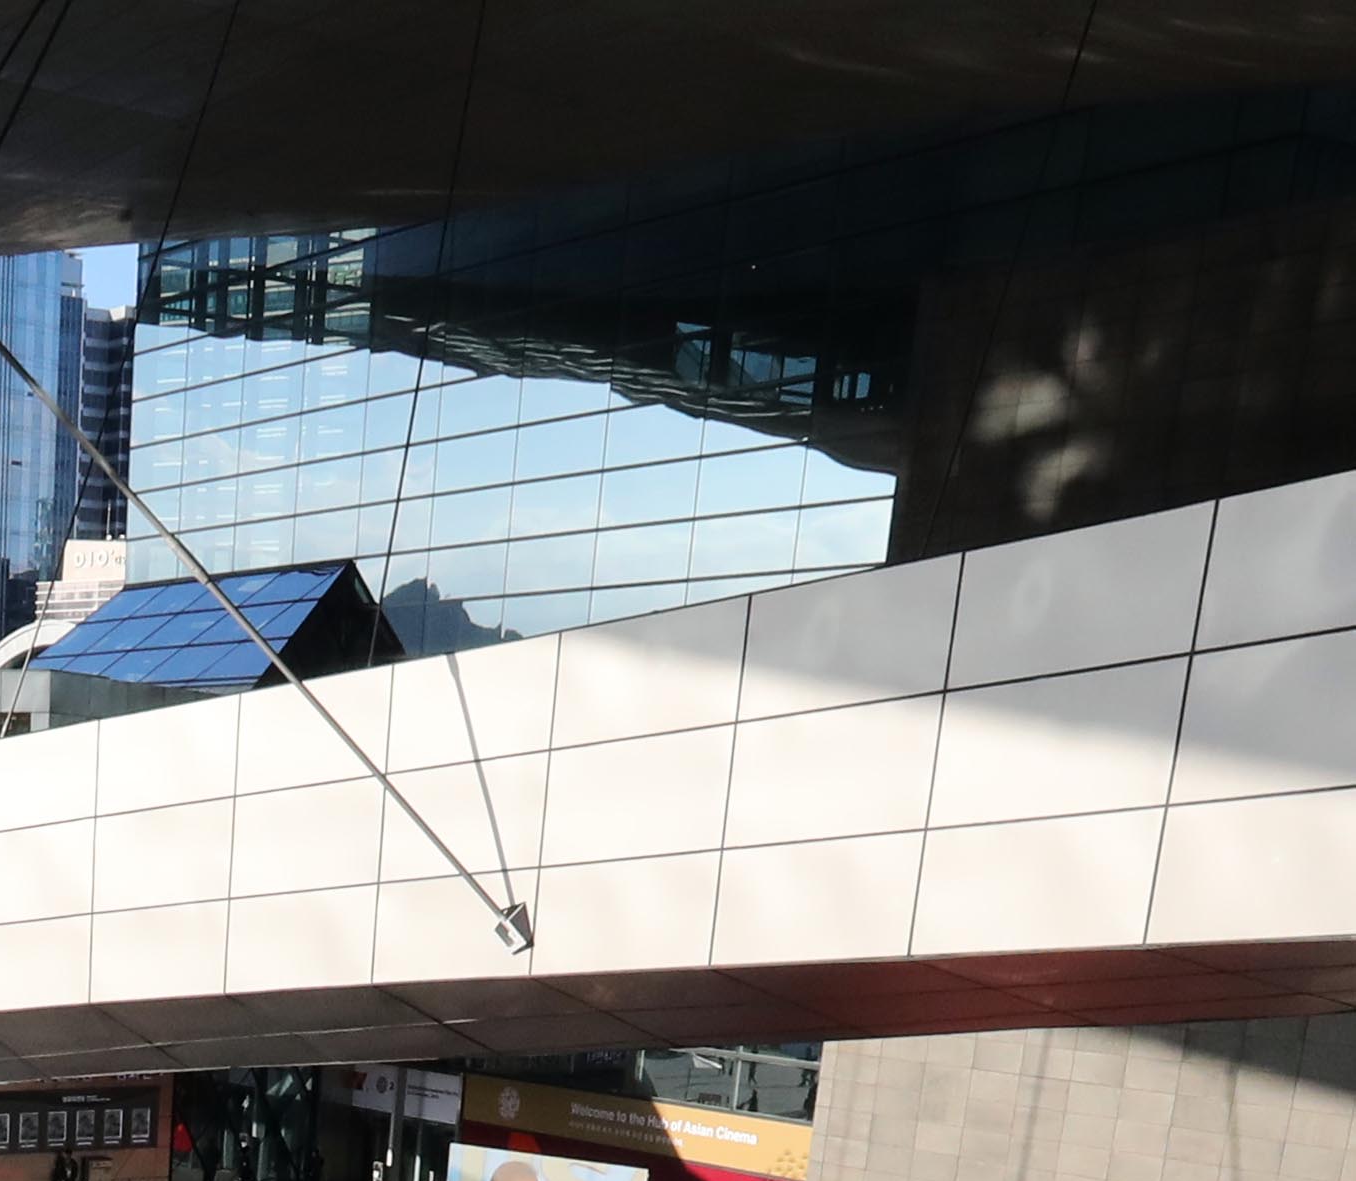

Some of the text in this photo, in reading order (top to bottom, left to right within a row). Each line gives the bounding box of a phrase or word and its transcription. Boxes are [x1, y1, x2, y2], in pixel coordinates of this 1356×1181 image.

[570, 1102, 615, 1121] Welcome
[616, 1108, 626, 1123] to
[627, 1111, 645, 1126] the
[646, 1114, 670, 1130] Hub
[670, 1118, 683, 1133] of
[683, 1121, 714, 1138] Asian
[715, 1126, 759, 1146] Cinema
